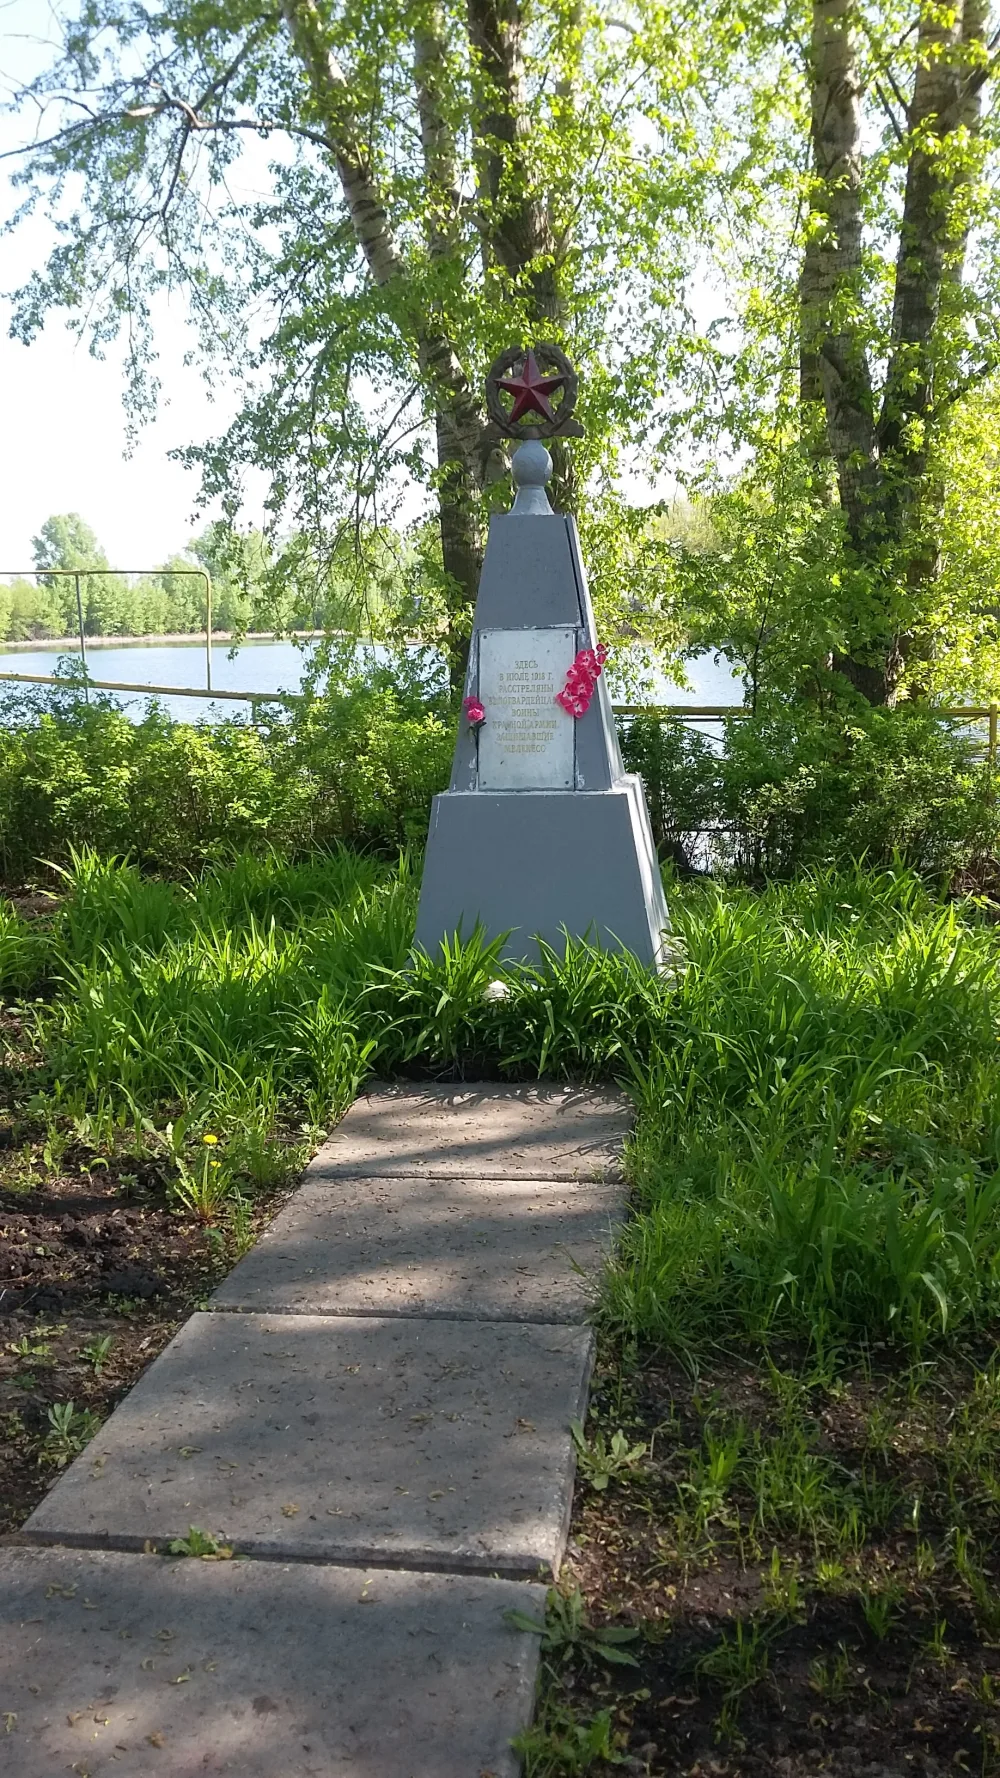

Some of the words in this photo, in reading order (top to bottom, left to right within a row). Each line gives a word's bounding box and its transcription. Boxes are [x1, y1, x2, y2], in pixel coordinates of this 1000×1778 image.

[514, 660, 539, 670] ЗДЕСЬ
[499, 672, 505, 681] В
[506, 672, 530, 681] ИЮЛЕ
[547, 672, 554, 681] Г.
[498, 684, 554, 693] РАССТРЕЛЯНЫ
[488, 695, 560, 705] БЕЛОГВАРДЕЙЦА
[511, 708, 540, 717] ВОИНЫ
